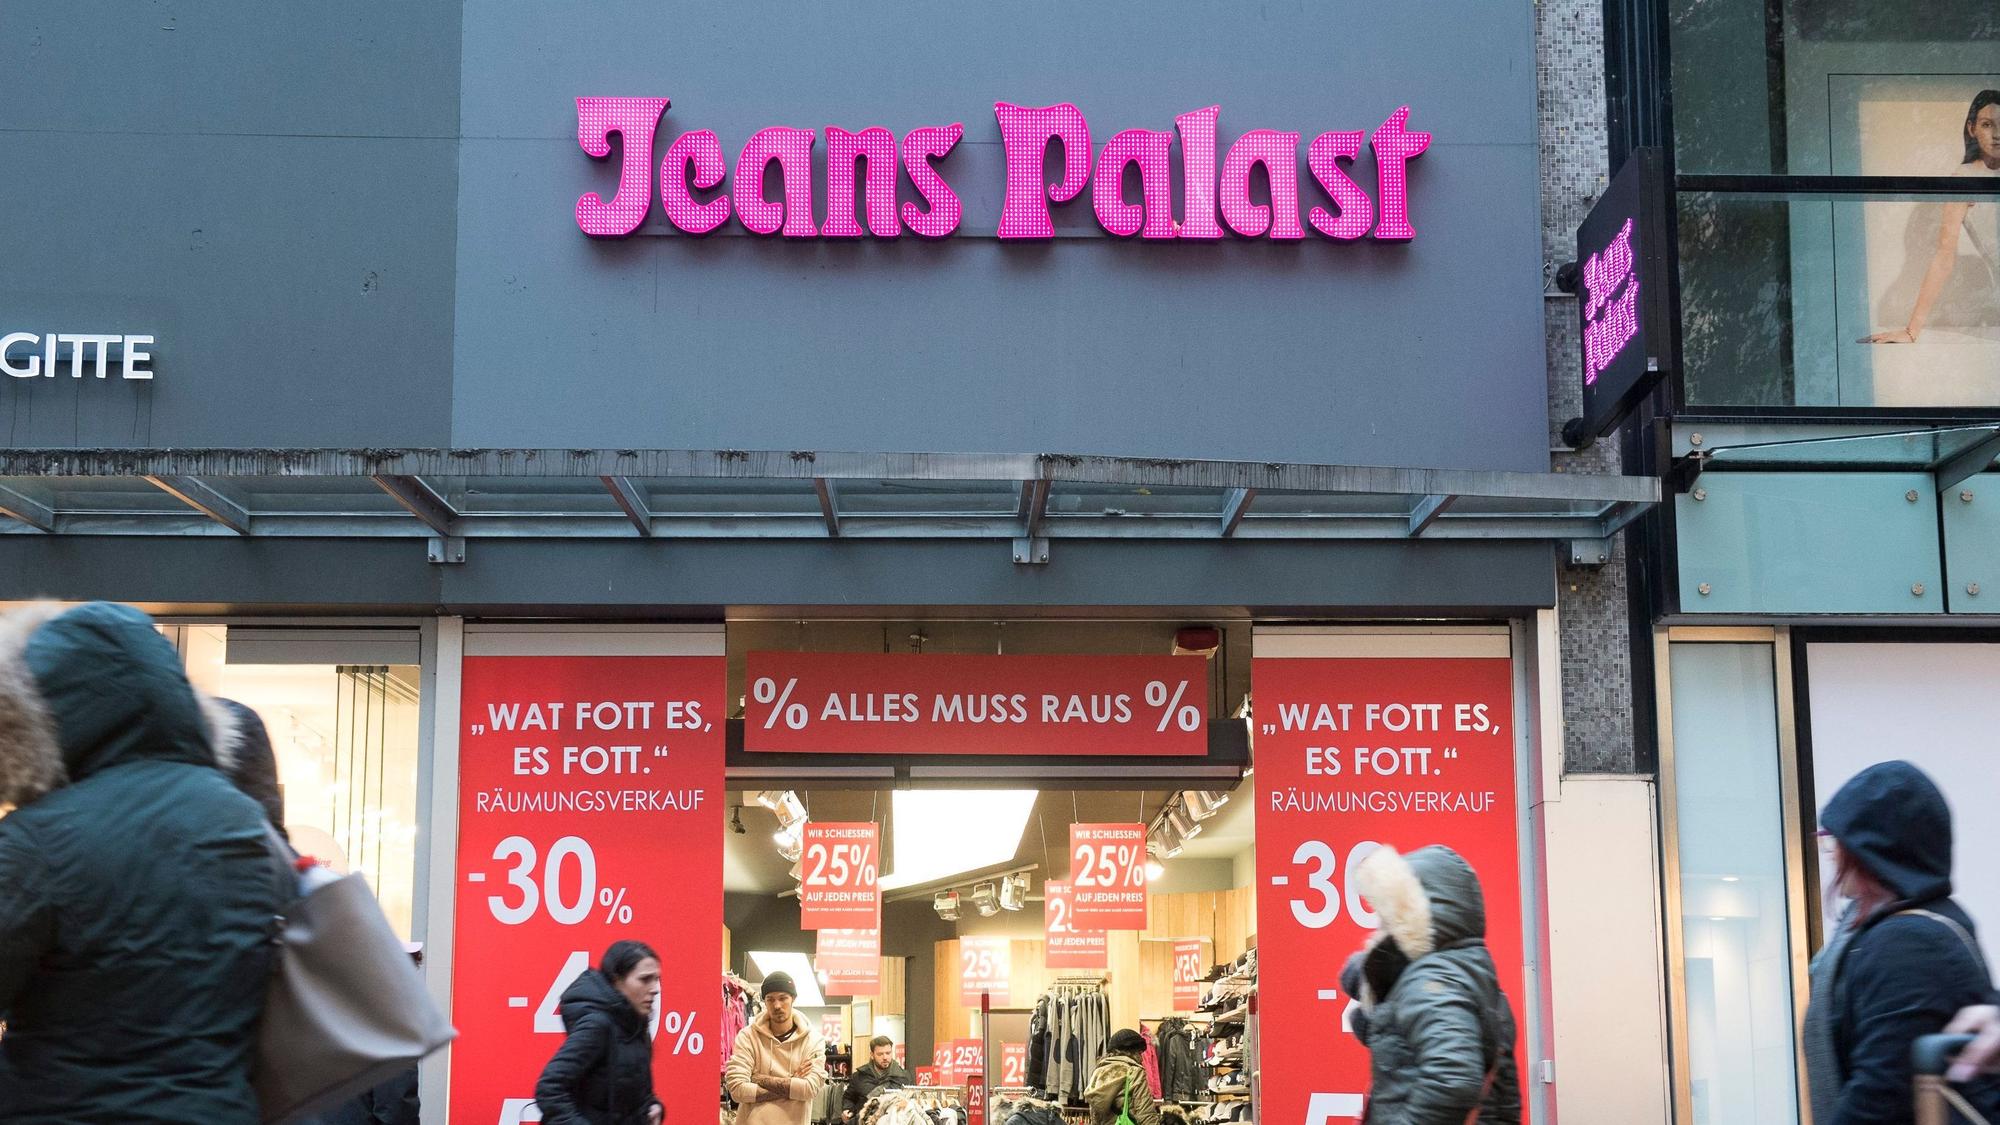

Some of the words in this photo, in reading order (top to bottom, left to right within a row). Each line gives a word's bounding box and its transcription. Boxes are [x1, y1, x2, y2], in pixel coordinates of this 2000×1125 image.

[576, 96, 964, 237] Jeans
[994, 102, 1432, 240] Palast
[0, 332, 155, 380] GITTE
[576, 701, 655, 731] FOTT
[666, 700, 712, 733] ES,
[753, 677, 809, 730] %
[820, 693, 920, 723] ALLES
[931, 694, 1028, 723] MUSS
[1041, 694, 1132, 723] RAUS
[1145, 680, 1201, 732] %
[1366, 703, 1442, 732] FOTT
[1455, 703, 1501, 735] ES,
[513, 747, 550, 776] ES
[1306, 747, 1342, 776] ES
[477, 787, 704, 814] RÄUMUNGSVERKAUF
[1271, 787, 1495, 813] RÄUMUNGSVERKAUF
[808, 829, 823, 838] WIR
[1075, 831, 1090, 839] WIR
[806, 843, 876, 886] 25%
[1075, 844, 1144, 887] 25%
[806, 892, 823, 902] AUF
[824, 892, 851, 902] JEDEN
[852, 892, 875, 902] PREIS
[1075, 892, 1092, 902] AUF
[1093, 892, 1119, 902] JEDEN
[1121, 892, 1143, 902] PREIS
[508, 951, 704, 1055] -4%
[824, 1023, 841, 1041] 25
